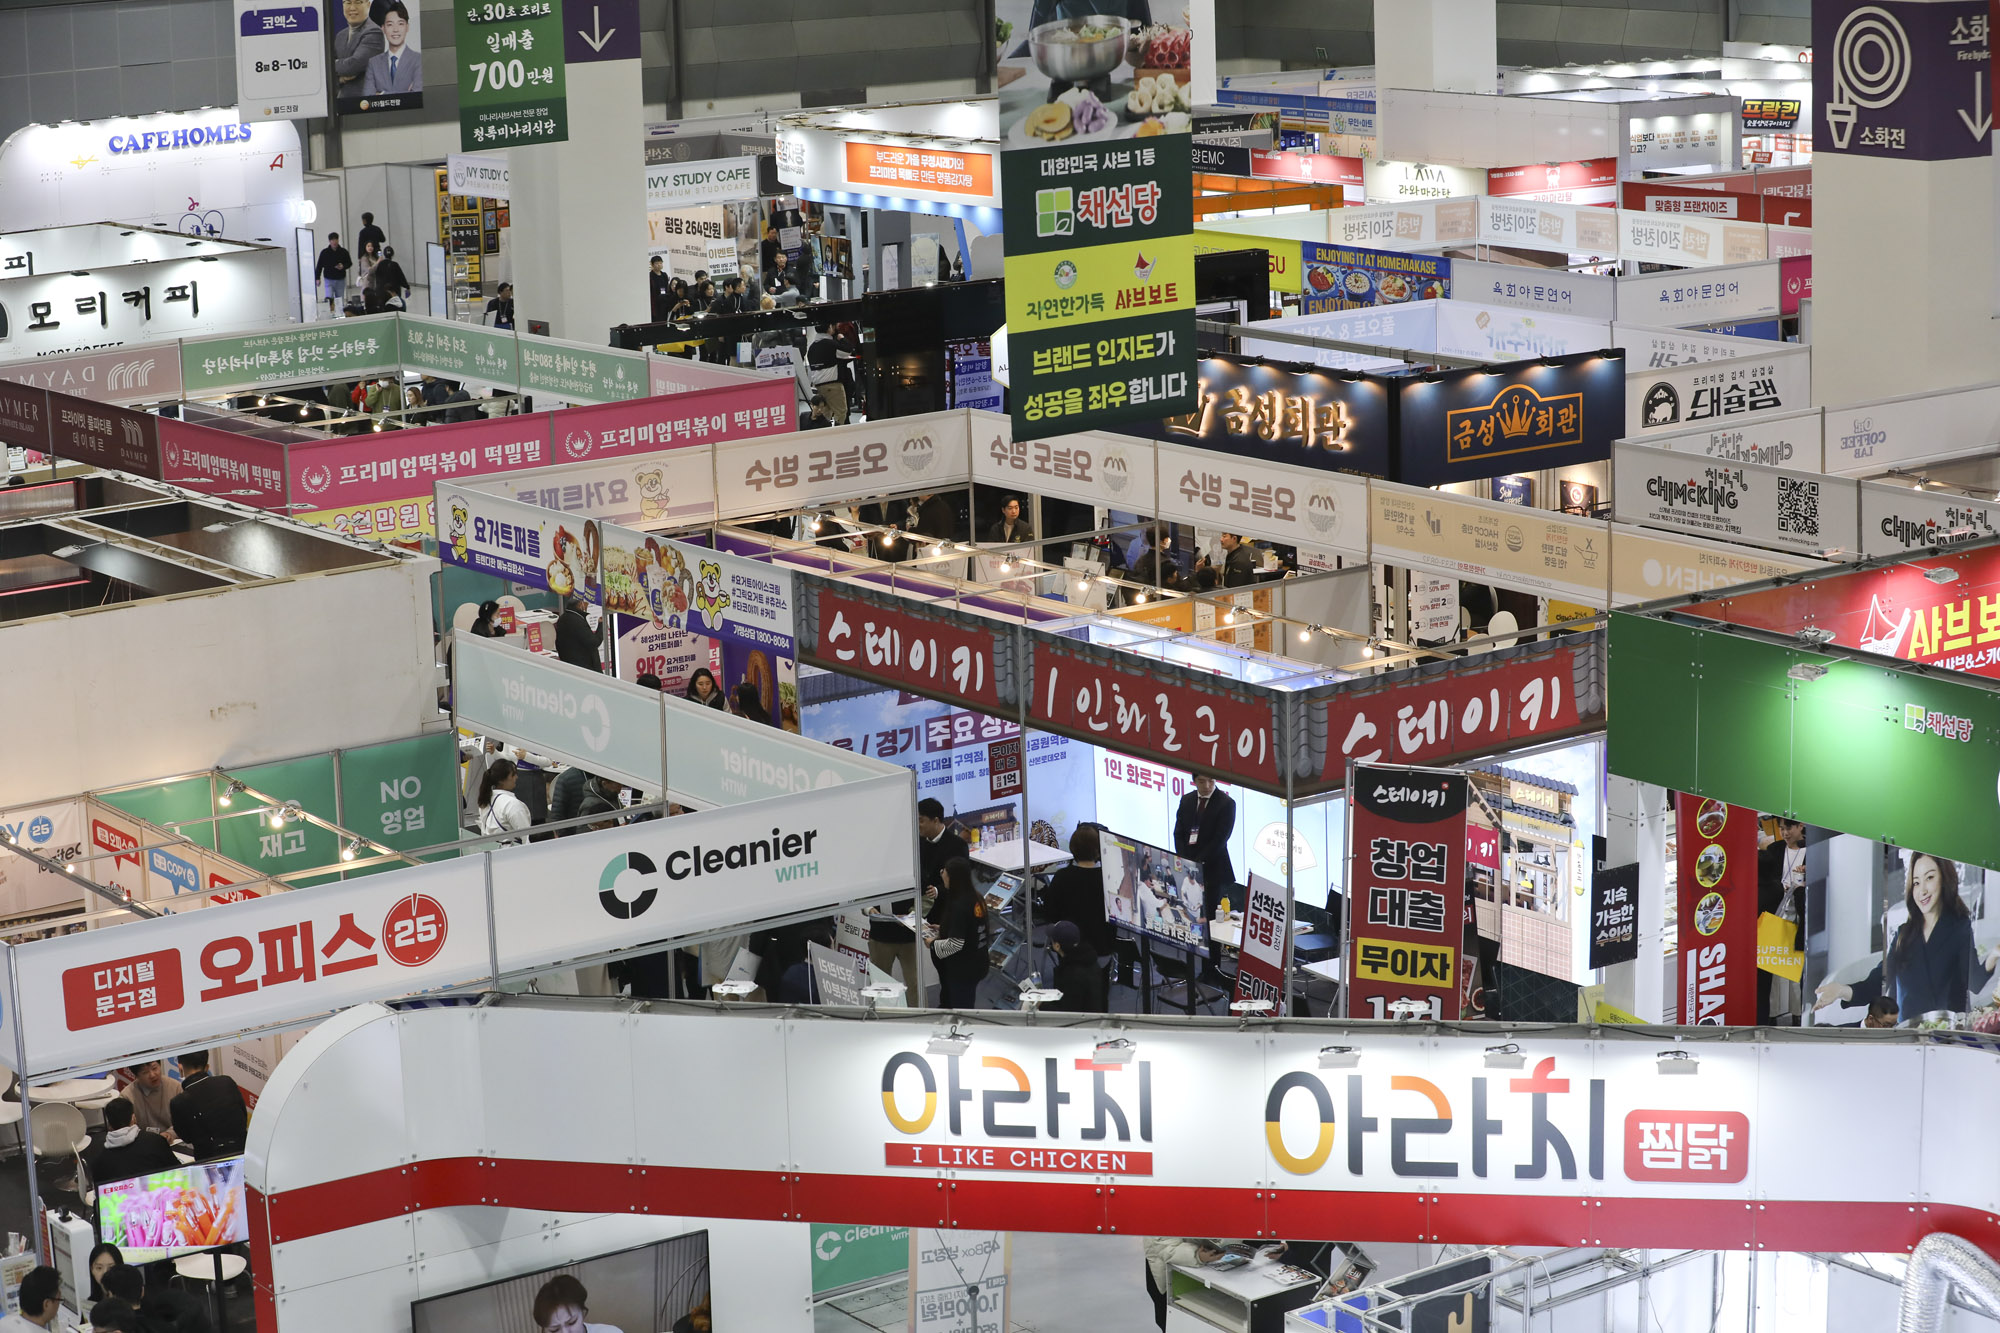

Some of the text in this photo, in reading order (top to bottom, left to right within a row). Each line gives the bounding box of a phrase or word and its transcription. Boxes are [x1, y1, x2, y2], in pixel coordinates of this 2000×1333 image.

[261, 15, 299, 30] 코엑스
[467, 2, 551, 22] 단, 30초 조리로
[486, 28, 535, 53] 일매출
[1948, 14, 1989, 46] 소화
[255, 60, 270, 73] 8월
[1957, 51, 1971, 61] Fire
[469, 58, 554, 93] 700만원
[273, 104, 299, 114] 월드전람
[371, 98, 401, 109] (주)월드전람
[522, 108, 536, 119] 전문
[536, 107, 549, 117] 창업
[108, 121, 253, 154] CAFEHOMES
[473, 120, 556, 143] 청록미나리식당
[1859, 126, 1906, 149] 소화전
[876, 151, 920, 167] 부드러운 가을
[1040, 148, 1156, 177] 대한민국 샤브 1등
[479, 168, 502, 181] STUDY
[672, 172, 712, 187] STUDY
[715, 167, 751, 182] CAFE
[869, 166, 973, 188] 프리미엄 만든 명품감자탕
[648, 188, 692, 198] PREMIUM
[1076, 180, 1162, 229] 채선당
[1655, 199, 1728, 214] 맞춤형 프랜차이즈
[664, 216, 722, 239] 평당 264만원
[708, 247, 736, 259] 이벤트
[1316, 247, 1437, 275] ENJOYING IT AT HOMEMAKASE
[1026, 282, 1178, 321] 자연한가득 샤브보트
[1492, 281, 1572, 305] 육회야문연어
[1659, 280, 1740, 304] 육회야문연어
[28, 280, 200, 330] 모리커피
[1032, 330, 1176, 376] 브랜드 인지도가
[1693, 365, 1774, 387] 프리미엄 김치 삼겹살
[1024, 371, 1188, 421] 성공을 좌우합니다
[1685, 378, 1782, 422] 돼슐랭
[61, 409, 113, 436] 프라이빗 풀파티룸
[600, 403, 787, 450] 프리미엄떡볶이 떡밀밀
[1217, 388, 1348, 452] 금성회관
[1453, 403, 1578, 450] 금성 회관
[72, 431, 105, 453] 데이메르
[120, 448, 149, 464] DAYMER
[338, 439, 541, 485] 프리미엄떡볶이 떡밀밀
[182, 448, 249, 483] 프리미엄떡볶이
[251, 465, 282, 492] 떡밀밀
[474, 516, 541, 559] 요거트퍼플
[474, 553, 496, 569] 트렌디한
[731, 574, 781, 596] #요거트아이스크림
[731, 587, 764, 607] #그릭요거트
[760, 606, 777, 621] #커피
[647, 639, 683, 653] 요거트퍼플!
[668, 630, 689, 642] 나타난
[733, 622, 790, 650] 가맹상담 1800-8084
[828, 610, 985, 694] 스테이키
[635, 653, 697, 677] 왜? 요거트퍼플
[666, 663, 690, 675] 일까요?
[1341, 675, 1563, 762] 스테이키
[1925, 711, 1974, 743] 채선당
[875, 716, 975, 757] 경기 주요
[991, 742, 1020, 758] 무이자
[1104, 758, 1122, 780] 1인
[379, 776, 422, 803] NO
[1372, 785, 1447, 808] 스테이키
[32, 826, 50, 838] 25
[381, 805, 426, 836] 영업
[259, 830, 307, 859] 재고
[665, 827, 818, 882] Cleanier
[166, 859, 187, 882] COPY
[774, 859, 820, 884] WITH
[1370, 837, 1448, 884] 창업
[1251, 889, 1286, 923] 선착순
[1603, 885, 1628, 906] 지속
[1367, 886, 1446, 933] 대출
[1595, 902, 1635, 926] 가능한
[1248, 912, 1275, 948] 5명
[1594, 922, 1634, 947] 수익성
[200, 912, 438, 1003] 오피스 25
[1360, 944, 1451, 981] 무이자
[1756, 945, 1790, 956] SUPER
[93, 960, 156, 991] 디지털
[95, 985, 158, 1018] 문구점
[1237, 969, 1280, 1012] 무이자
[880, 1048, 1153, 1143] 아라치
[1264, 1055, 1606, 1181] 아라치
[912, 1146, 1128, 1171] I LIKE CHICKEN
[1638, 1121, 1735, 1172] 찜닭
